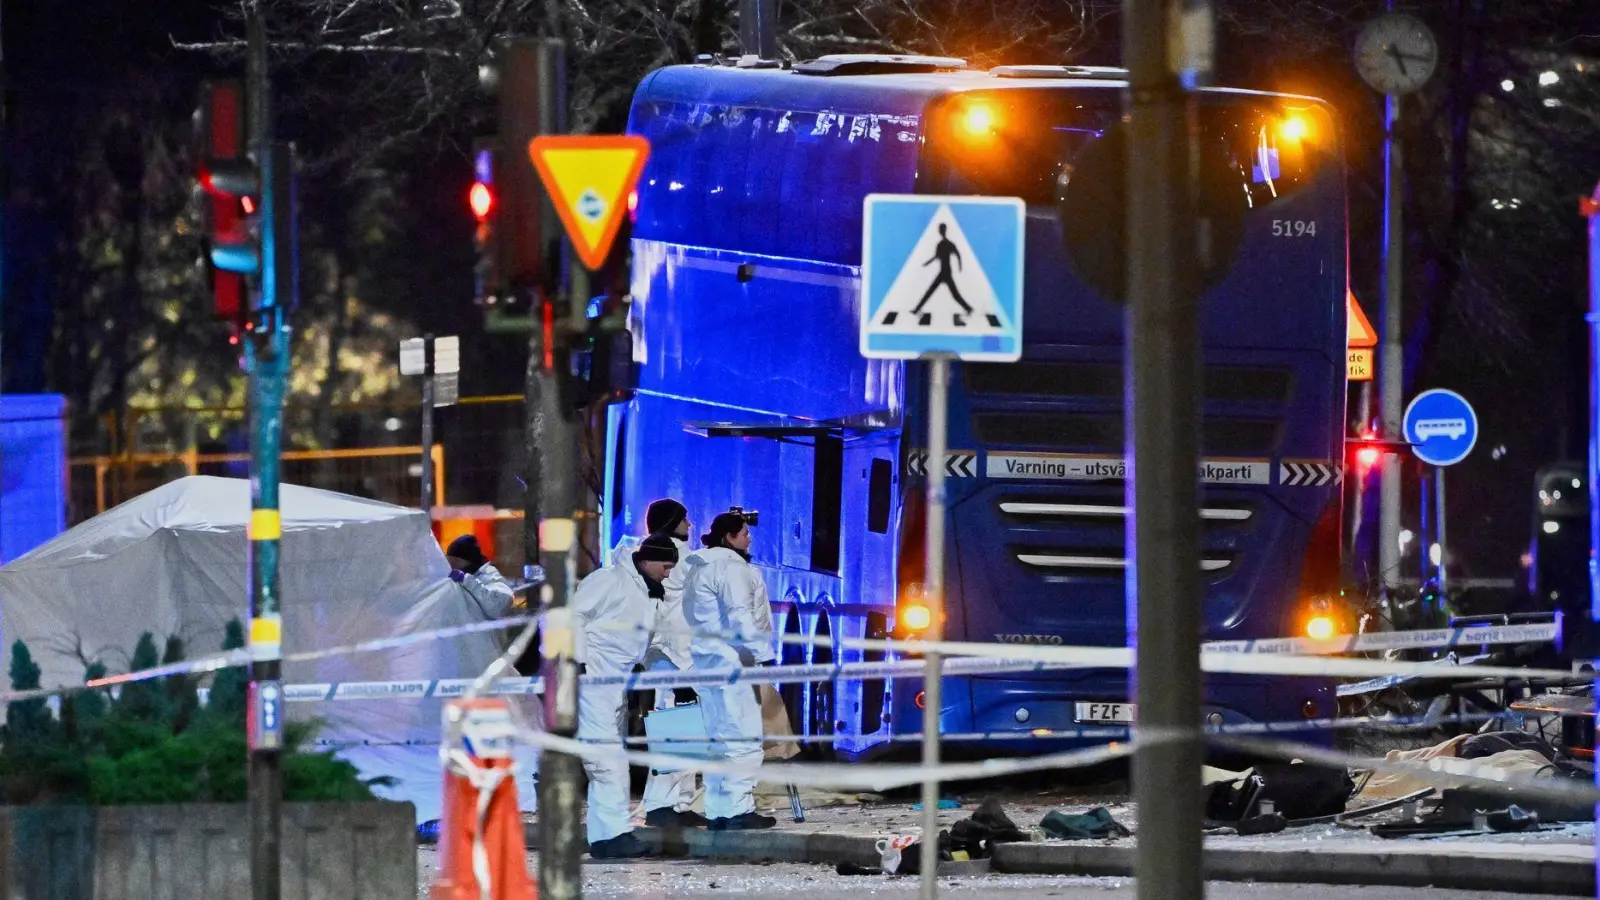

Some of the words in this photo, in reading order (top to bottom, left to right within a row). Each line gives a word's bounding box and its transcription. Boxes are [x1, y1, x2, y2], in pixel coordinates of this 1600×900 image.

[1272, 220, 1316, 236] 5194
[1349, 353, 1363, 362] de
[1350, 366, 1364, 376] fik
[1006, 459, 1065, 477] Varning
[1085, 460, 1126, 476] utsvä
[1200, 463, 1252, 481] akparti
[994, 634, 1063, 645] VOLVO
[1090, 704, 1120, 719] FZF
